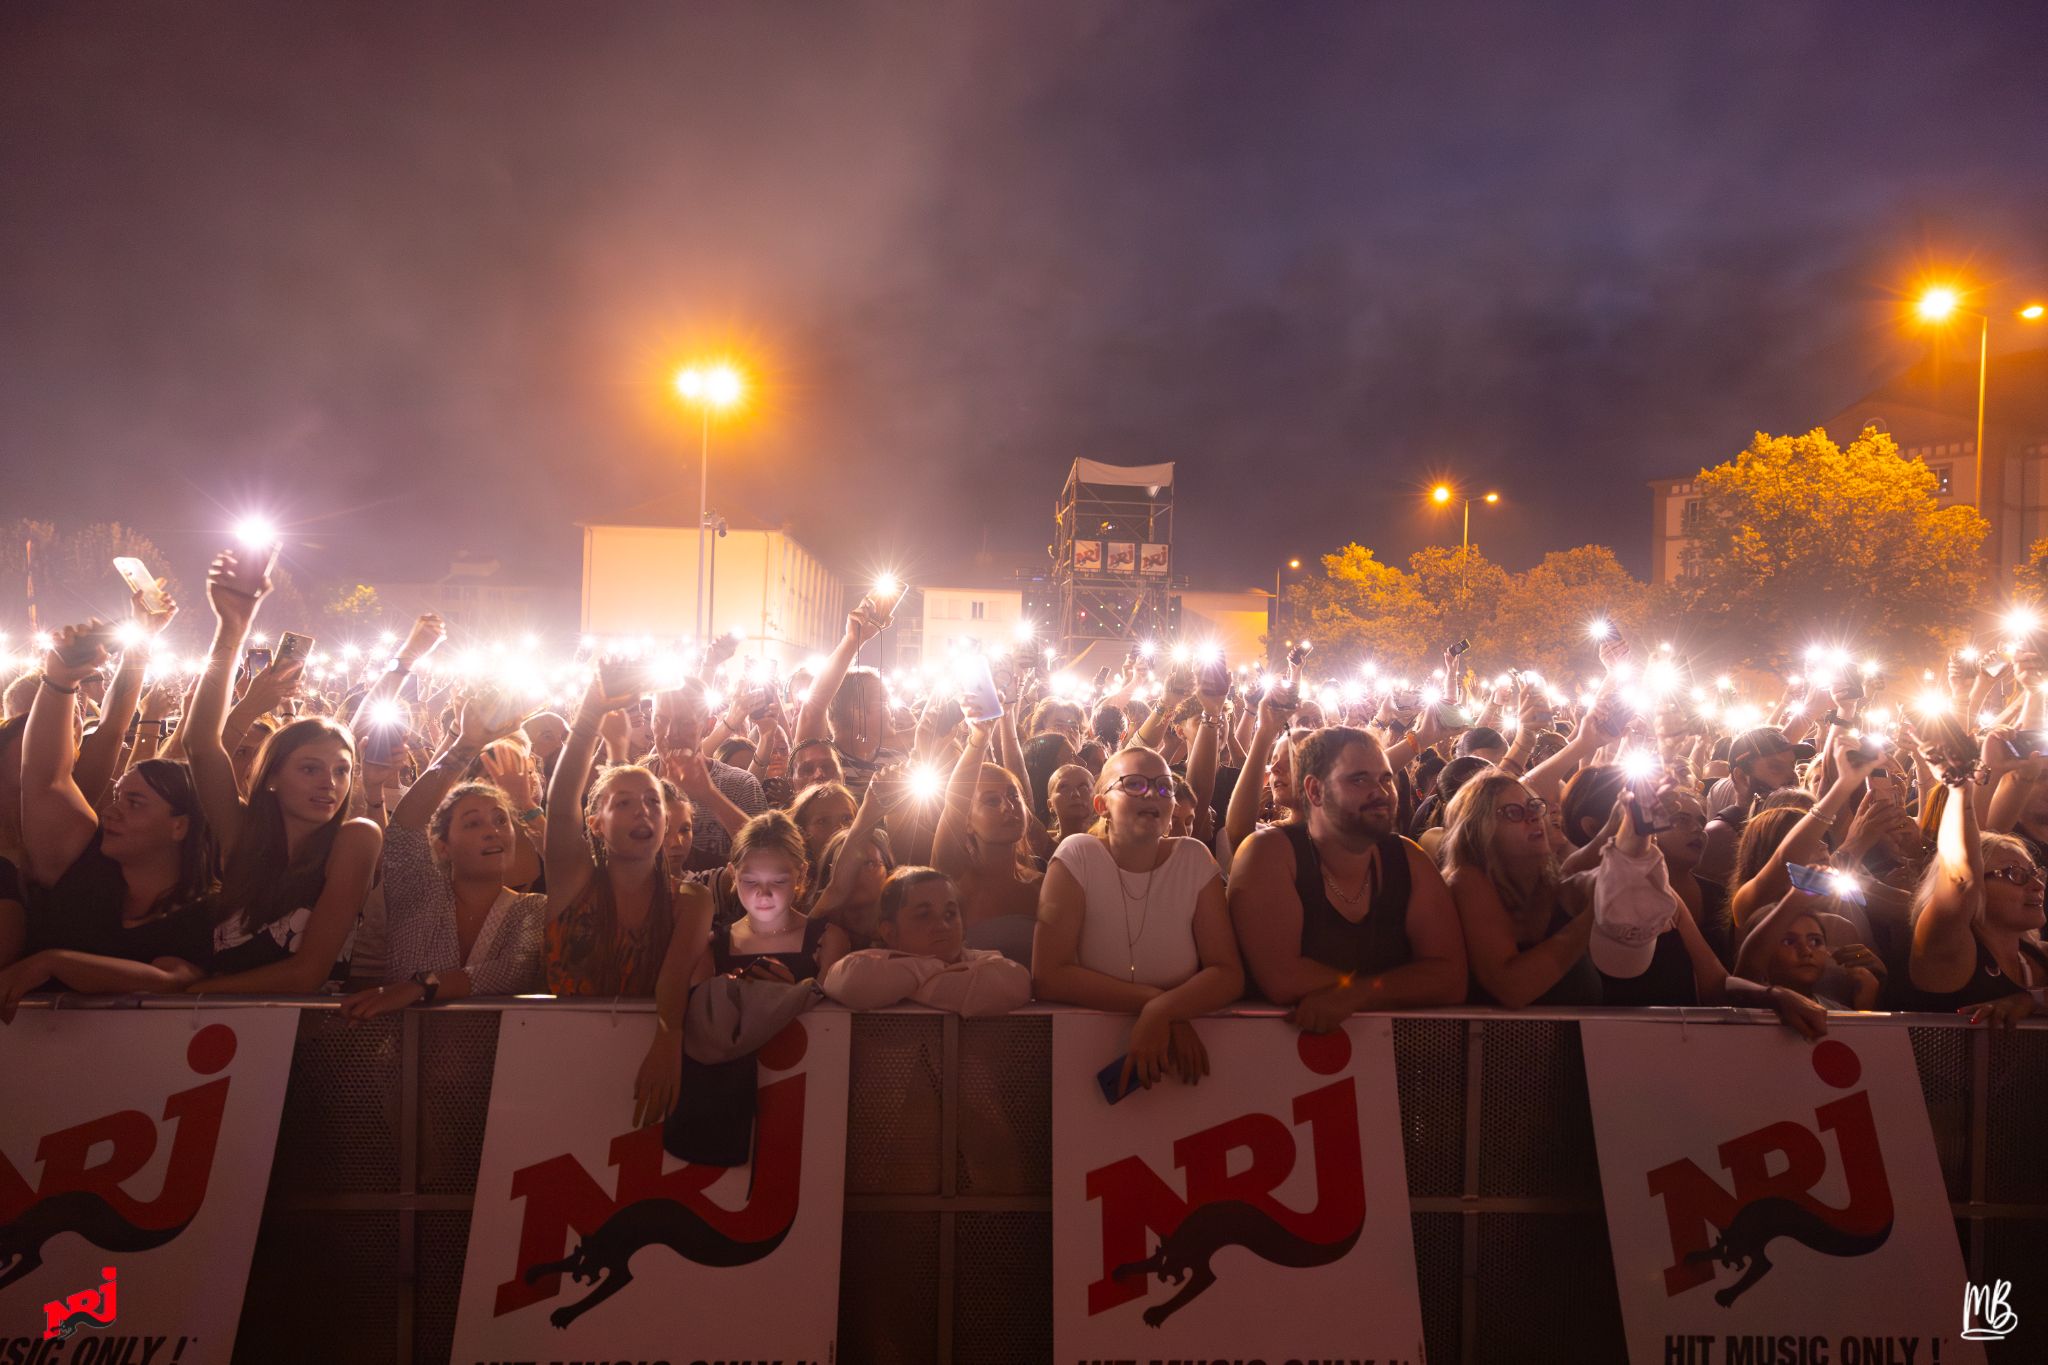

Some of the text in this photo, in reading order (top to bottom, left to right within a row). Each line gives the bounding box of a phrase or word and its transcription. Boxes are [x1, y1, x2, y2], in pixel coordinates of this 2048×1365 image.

[1086, 1023, 1366, 1317] NRJ
[1646, 1040, 1895, 1297] NRJ
[71, 1336, 167, 1365] ONLY
[1664, 1335, 1715, 1365] HIT
[1725, 1335, 1829, 1365] MUSIC
[1840, 1336, 1919, 1365] ONLY
